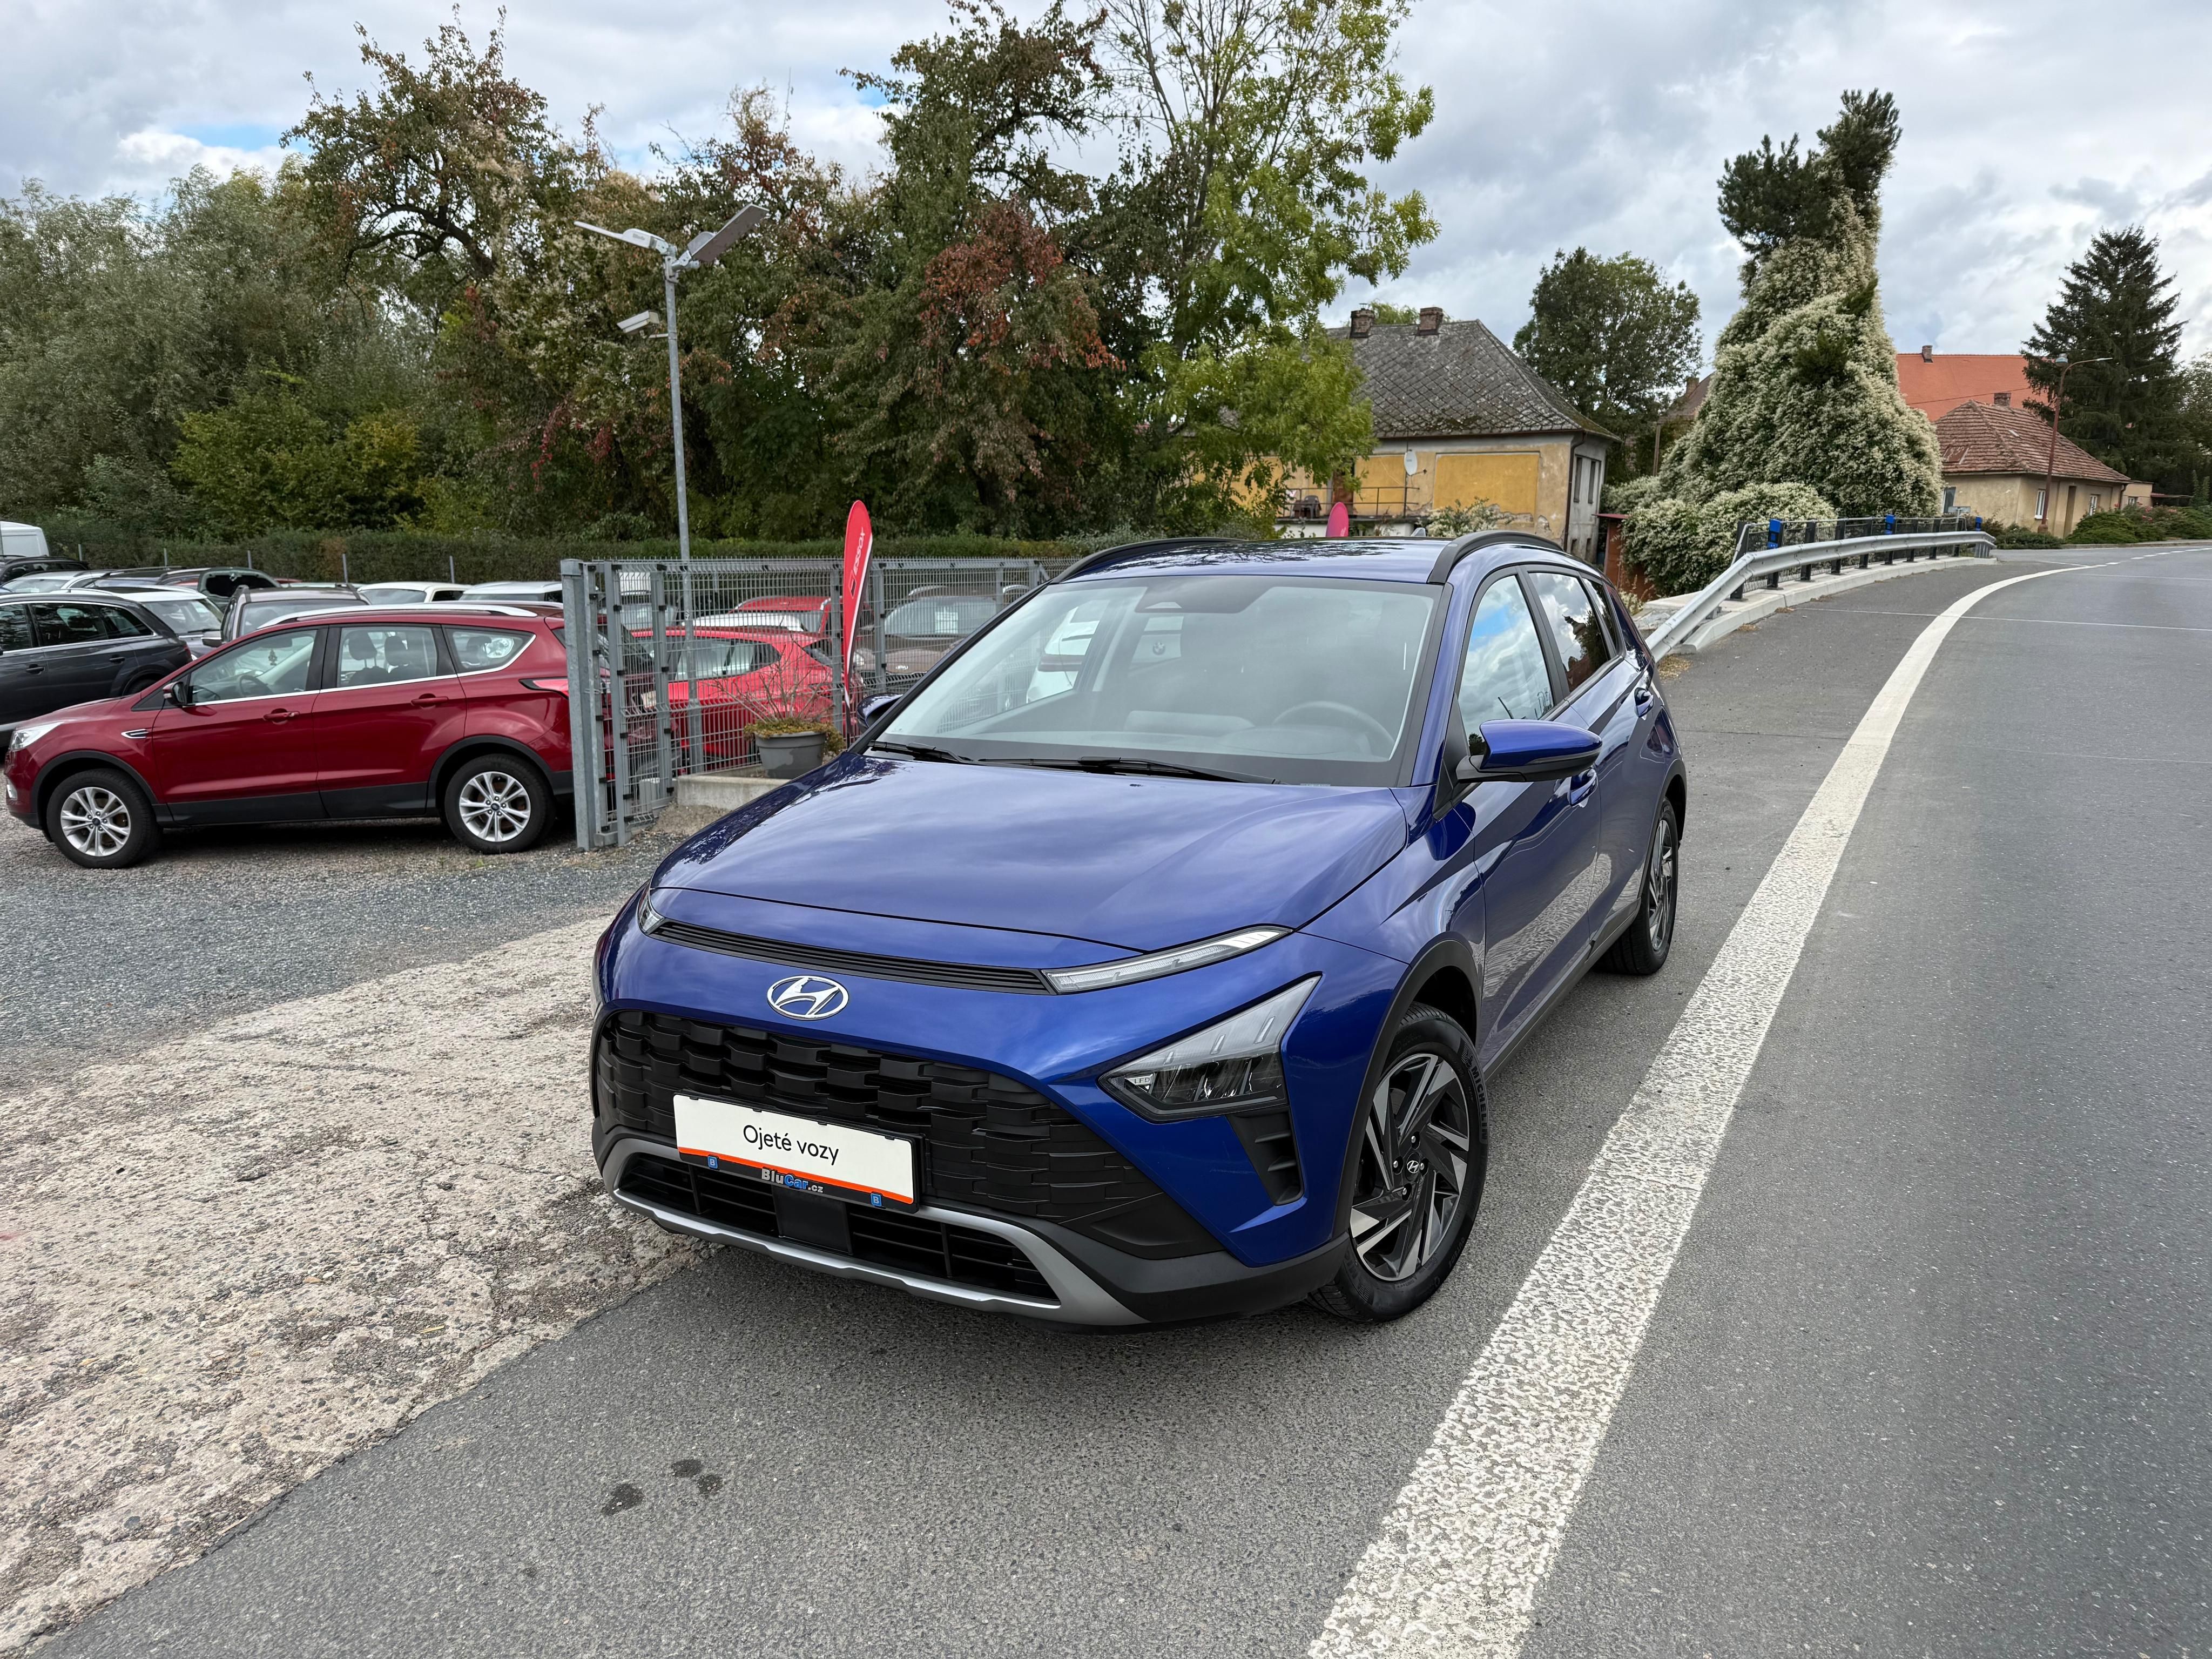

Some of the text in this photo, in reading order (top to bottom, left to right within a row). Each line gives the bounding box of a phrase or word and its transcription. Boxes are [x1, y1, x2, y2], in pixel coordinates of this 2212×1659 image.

[1471, 1065, 1487, 1140] MICHELIN
[743, 1124, 839, 1165] Ojeté vozy
[761, 1169, 824, 1193] BluCar.cz
[873, 1196, 880, 1204] B
